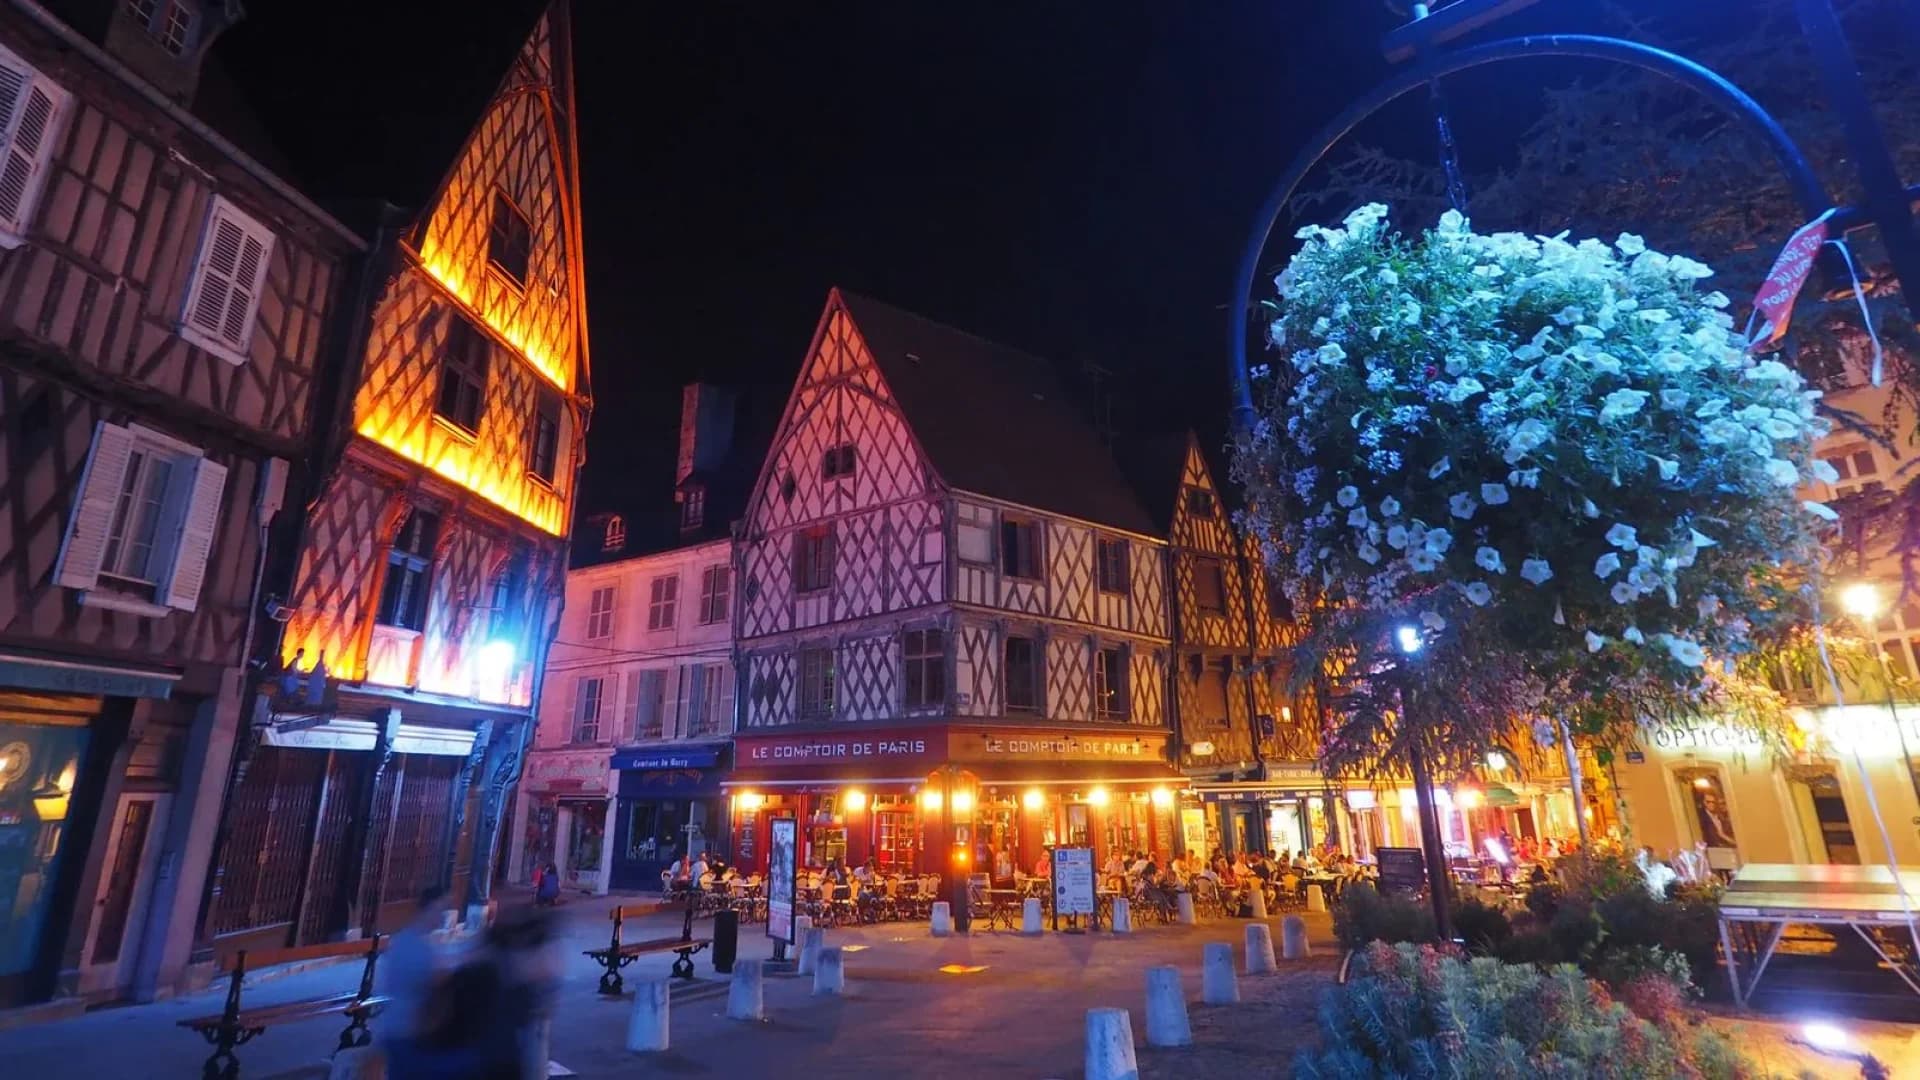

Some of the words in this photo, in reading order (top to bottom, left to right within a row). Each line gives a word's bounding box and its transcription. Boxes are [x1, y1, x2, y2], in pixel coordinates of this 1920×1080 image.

[752, 746, 769, 759] LE
[774, 743, 846, 758] COMPTOIR
[852, 742, 873, 755] DE
[878, 740, 926, 755] PARIS
[985, 740, 1003, 753] LE
[1008, 741, 1078, 754] COMPTOIR
[1083, 742, 1100, 754] DE
